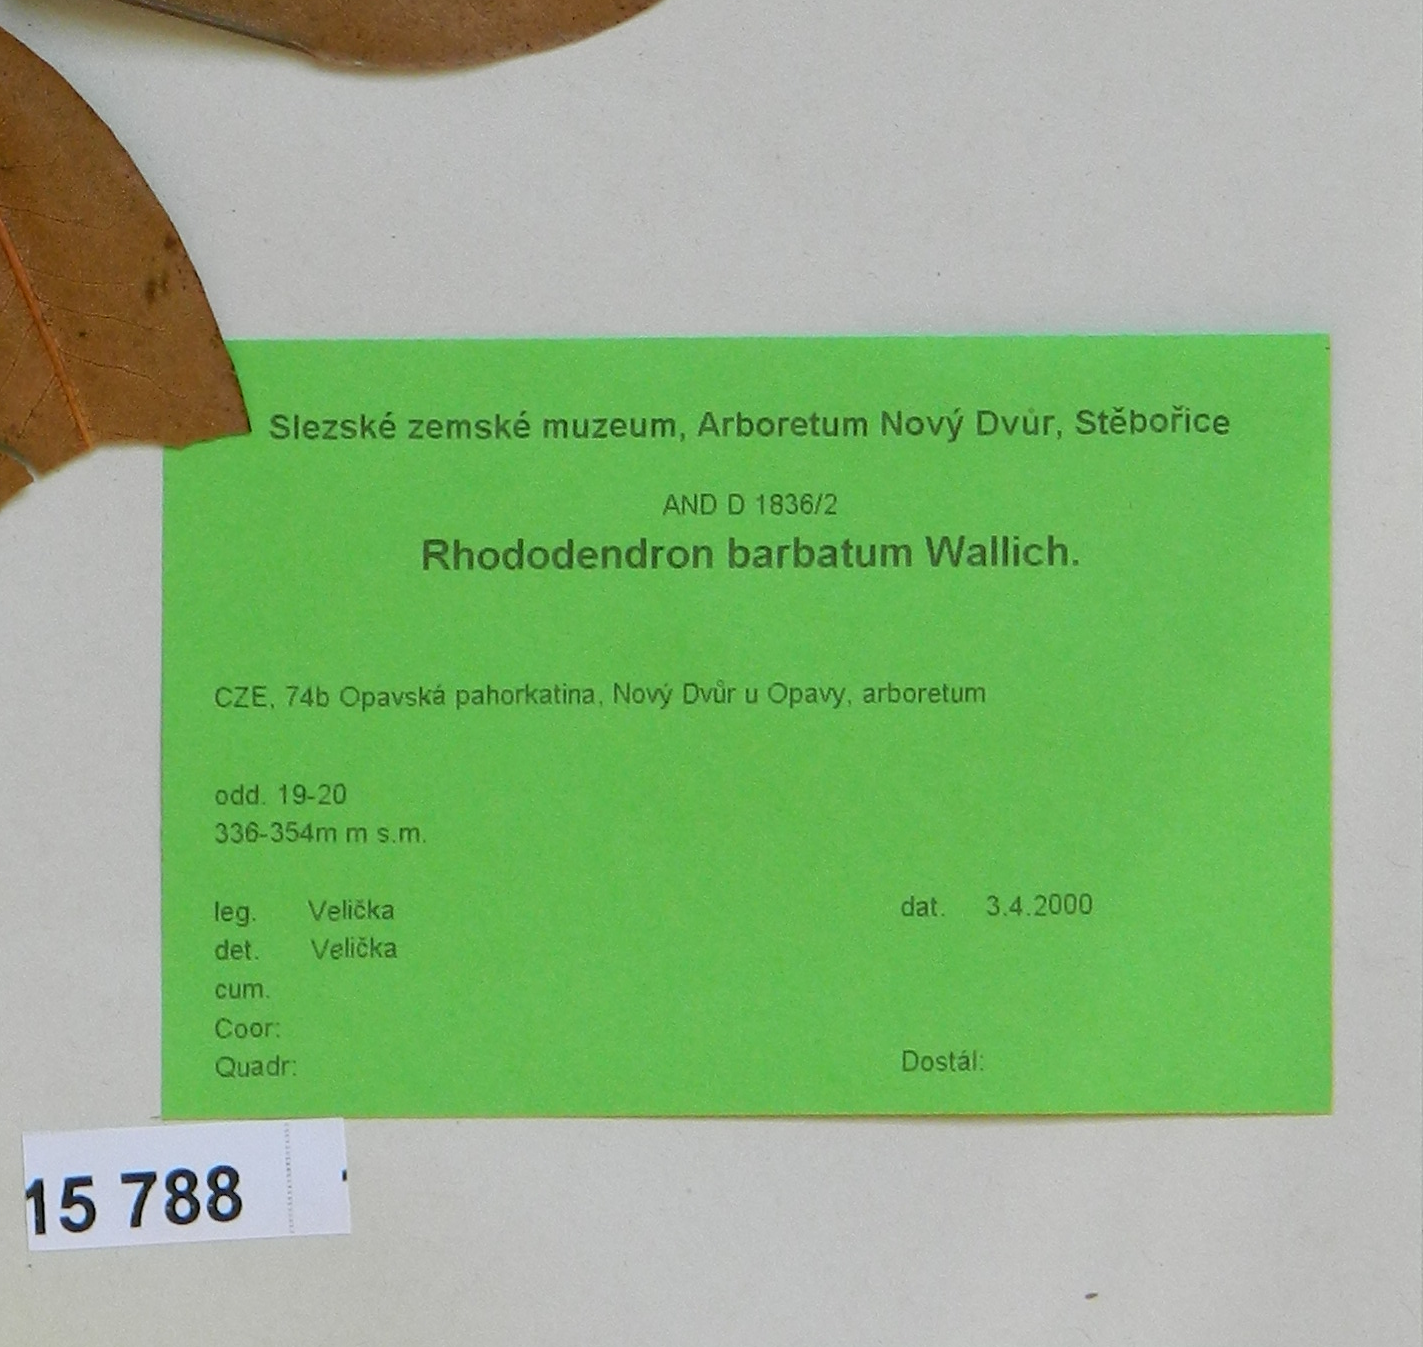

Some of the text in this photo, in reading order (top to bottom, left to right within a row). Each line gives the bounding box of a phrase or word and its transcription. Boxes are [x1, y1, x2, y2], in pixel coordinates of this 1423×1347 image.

[268, 404, 1231, 443] Slezské zemské muzeum, Arboretum Nový Dvůr, Stěbořice
[662, 492, 838, 516] AND D 1836/2
[422, 534, 1080, 571] Rhododendron barbatum Wallich.
[286, 685, 330, 708] 74b
[339, 683, 446, 713] Opavská
[455, 682, 604, 711] pahorkatina,
[613, 681, 673, 710] Nový
[682, 680, 737, 706] Dvůr
[745, 687, 759, 705] u
[766, 682, 853, 710] Opavy,
[862, 682, 986, 704] arboretum
[214, 782, 347, 807] odd. 19-20
[215, 820, 427, 845] 336-354m m s.m.
[214, 898, 395, 928] leg. Velička
[900, 893, 1093, 918] dat. 3.4.2000
[214, 936, 398, 961] det. Velička
[214, 981, 271, 1000] cum.
[214, 1017, 281, 1040] Coor:
[215, 1054, 298, 1079] Quadr:
[901, 1048, 985, 1073] Dostál:
[25, 1164, 244, 1236] 15 788
